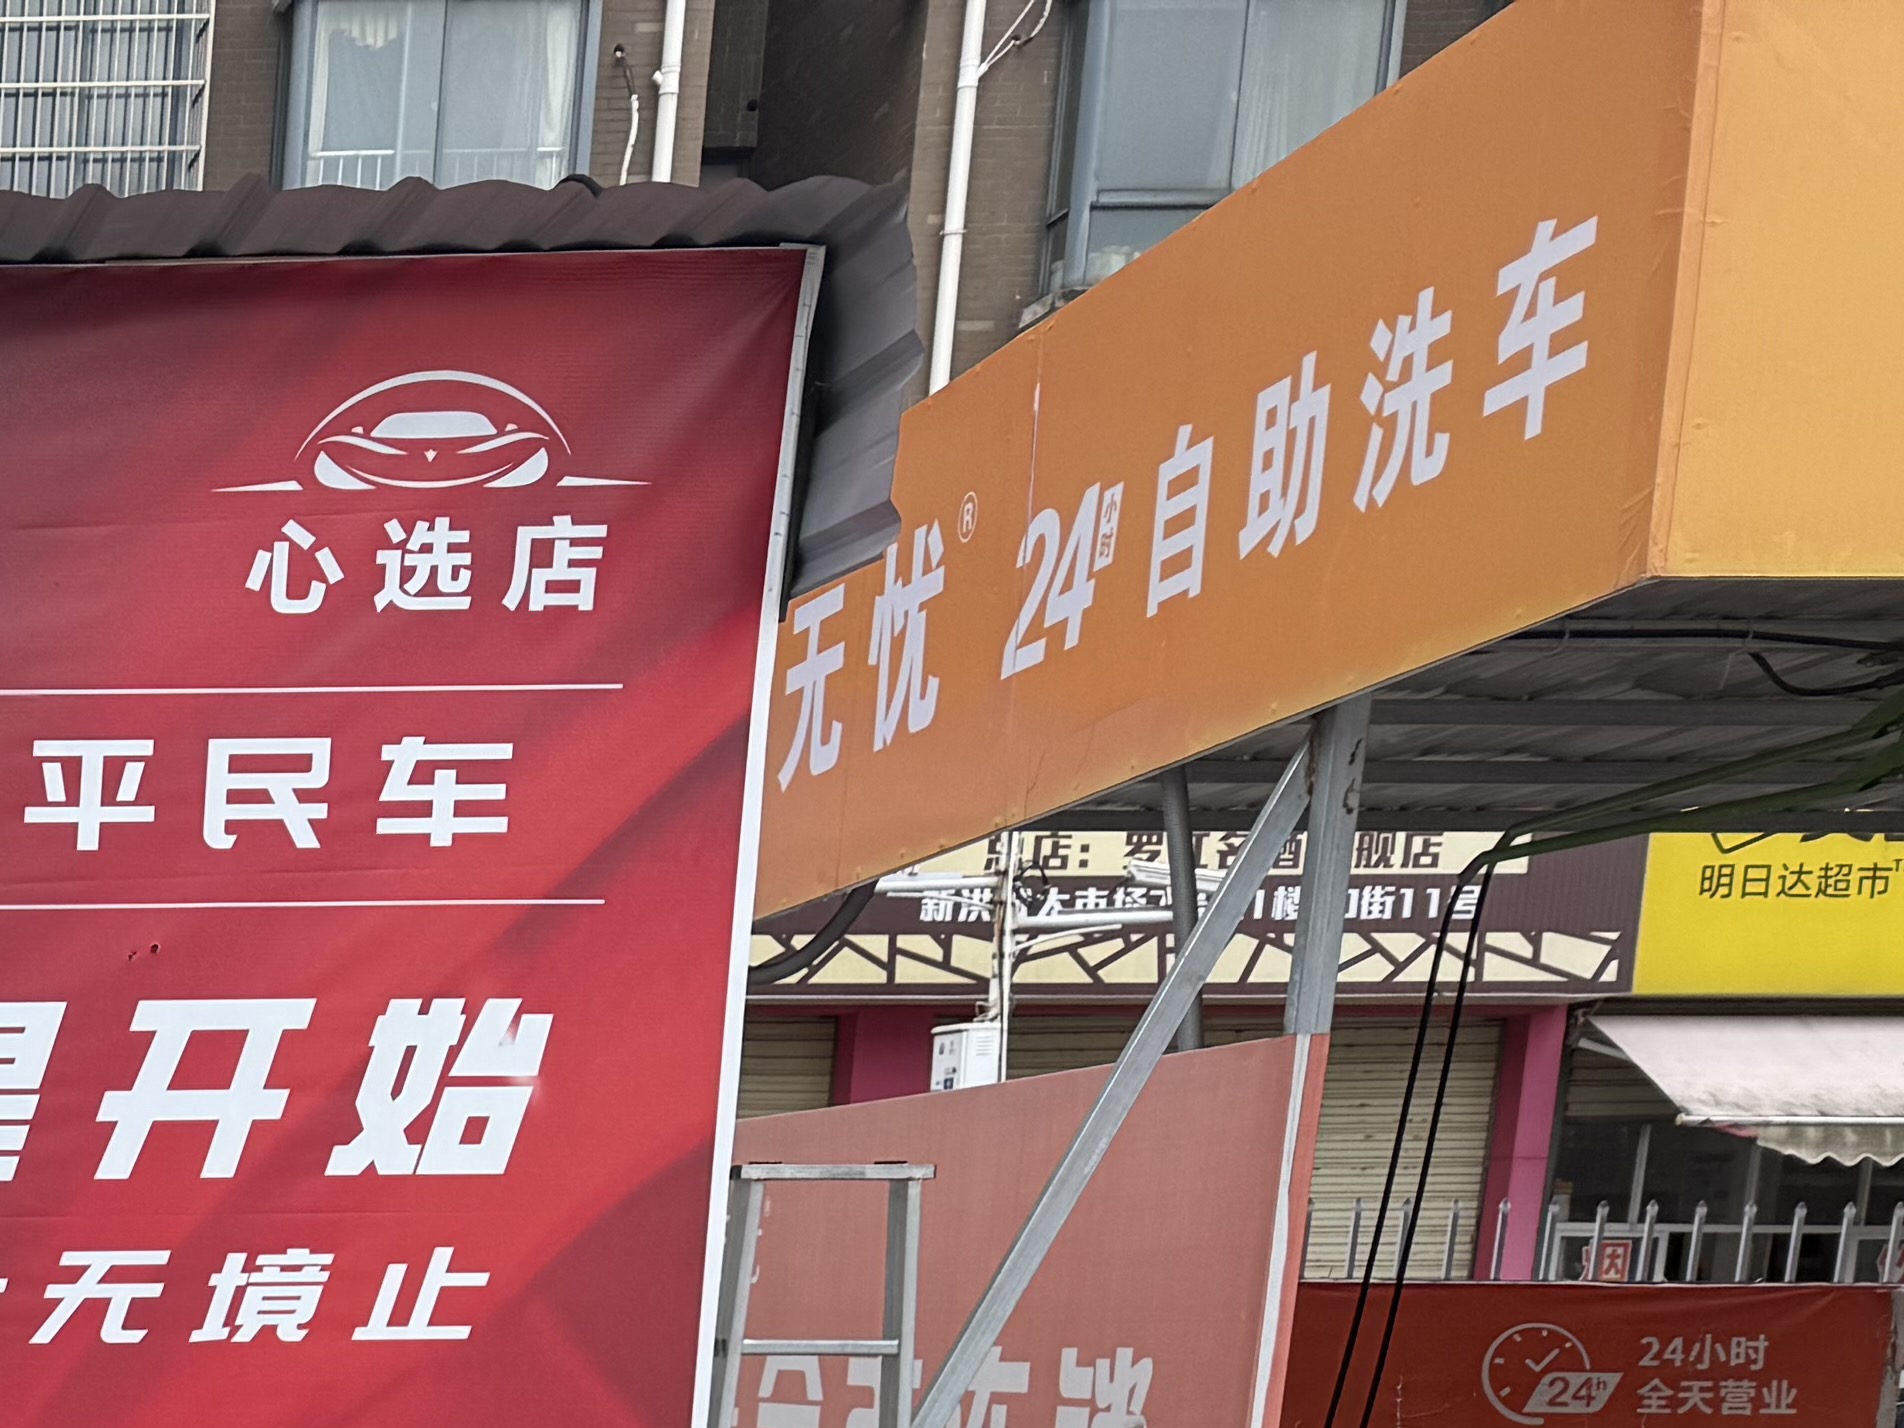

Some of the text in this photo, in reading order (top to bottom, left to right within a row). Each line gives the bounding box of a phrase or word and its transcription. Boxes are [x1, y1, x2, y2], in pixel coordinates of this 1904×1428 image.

[777, 519, 945, 792] 无忧
[1146, 216, 1597, 618] 自助洗车
[244, 515, 609, 615] 心选店
[1699, 862, 1893, 899] 明日达超市
[1638, 1333, 1770, 1372] 24小时
[1636, 1377, 1798, 1416] 全天营业
